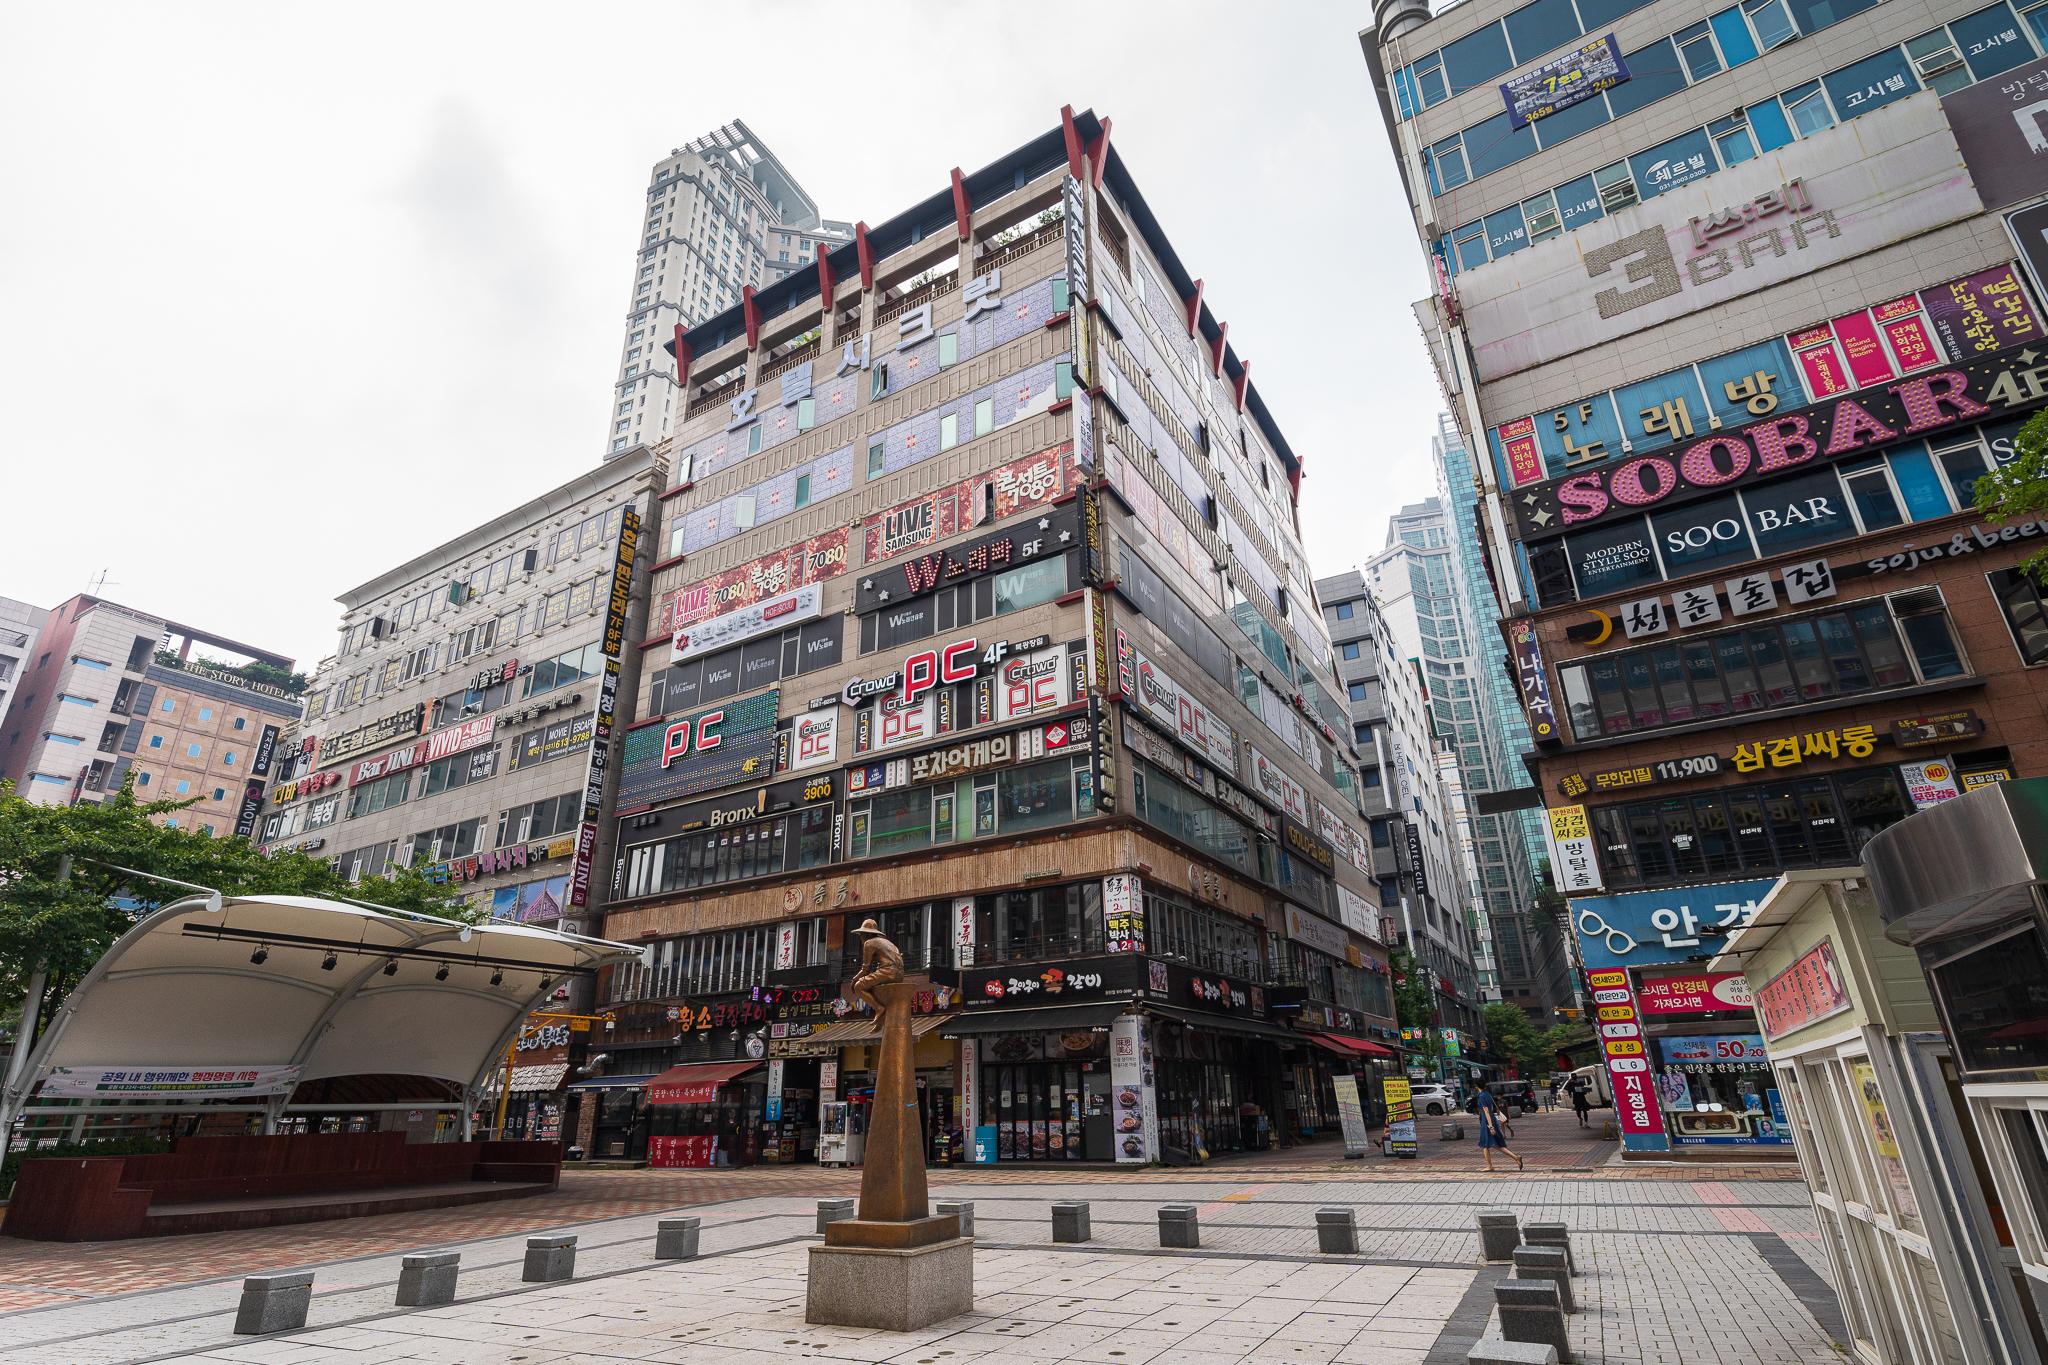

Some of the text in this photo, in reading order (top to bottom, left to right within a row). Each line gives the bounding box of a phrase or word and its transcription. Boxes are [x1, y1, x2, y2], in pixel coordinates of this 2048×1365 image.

[1968, 29, 2018, 56] 고시텔
[1846, 73, 1907, 108] 고시텔
[1564, 198, 1599, 219] 고시텔
[1492, 227, 1525, 248] 고시텔
[1891, 322, 1918, 337] 단체
[1896, 333, 1922, 346] 회식
[1554, 402, 1593, 434] 5F
[1562, 369, 1779, 468] 노래방
[1556, 369, 1990, 527] SOOBAR
[998, 460, 1056, 493] 콘서트
[1008, 473, 1055, 507] 7080
[885, 500, 933, 541] LIVE
[1667, 496, 1836, 553] SOO BAR
[885, 526, 932, 554] SAMSUNG
[1585, 540, 1643, 561] MODERN
[809, 544, 845, 572] 7080
[903, 551, 945, 594] W
[1022, 538, 1043, 557] 5F
[1582, 547, 1650, 571] STYLE SOO
[1588, 556, 1650, 576] ENTERTAINMENT
[676, 586, 710, 616] LIVE
[713, 581, 746, 605] 7080
[1626, 561, 1832, 633] 청춘술집
[610, 616, 624, 628] 7F
[675, 607, 708, 626] SAMSUNG
[606, 642, 620, 653] 9F
[607, 629, 622, 641] 8F
[903, 637, 978, 703] PC
[983, 640, 1008, 664] 4F
[1117, 628, 1131, 696] PC
[184, 661, 206, 677] THE
[211, 669, 246, 687] STORY
[252, 680, 286, 699] HOTEL
[1520, 653, 1549, 714] 나가수
[882, 689, 924, 725] PC
[1007, 675, 1057, 718] PC
[1179, 694, 1208, 744] PC
[1539, 724, 1549, 732] 4F
[428, 729, 462, 761] VIVID
[548, 726, 568, 741] MOVIE
[661, 710, 724, 769] PC
[800, 733, 829, 760] PC
[473, 751, 493, 765] 방탈출
[912, 735, 1011, 780] 포차어게인
[1731, 723, 1878, 773] 삼겹싸롱
[357, 746, 416, 782] Bar JINI
[742, 757, 758, 772] 4F
[1395, 750, 1410, 798] HOTEL CIEL
[1595, 755, 1718, 789] 무한리필 11,900
[1926, 766, 1946, 779] NO!
[272, 782, 298, 805] 디바
[803, 783, 831, 801] 3900
[710, 806, 756, 827] Bronx
[1555, 815, 1586, 828] 삼겹
[833, 814, 844, 850] Bronx
[452, 860, 478, 881] 전통
[482, 847, 528, 874] 마사지
[531, 846, 545, 862] 3F
[574, 829, 595, 891] Bar JINI
[1565, 842, 1591, 888] 방탈출
[614, 859, 624, 890] Bronx
[1415, 870, 1425, 890] CIEL
[1108, 919, 1130, 930] 맥주
[1109, 930, 1130, 941] 박사
[1007, 977, 1040, 995] 구이구이
[1592, 974, 1623, 985] 연세안과
[1671, 979, 1710, 994] 안경테
[1653, 996, 1703, 1009] 가져오시면
[679, 1006, 713, 1032] 황소
[772, 1024, 786, 1033] LIVE
[1614, 1043, 1636, 1052] 삼성
[101, 1072, 126, 1082] 공원
[128, 1072, 142, 1082] 내
[144, 1071, 189, 1082] 행위제한
[1664, 1062, 1747, 1074] 좋은 인상을 만들어
[964, 1063, 972, 1139] TAKE OUT
[1624, 1075, 1650, 1127] 지정점
